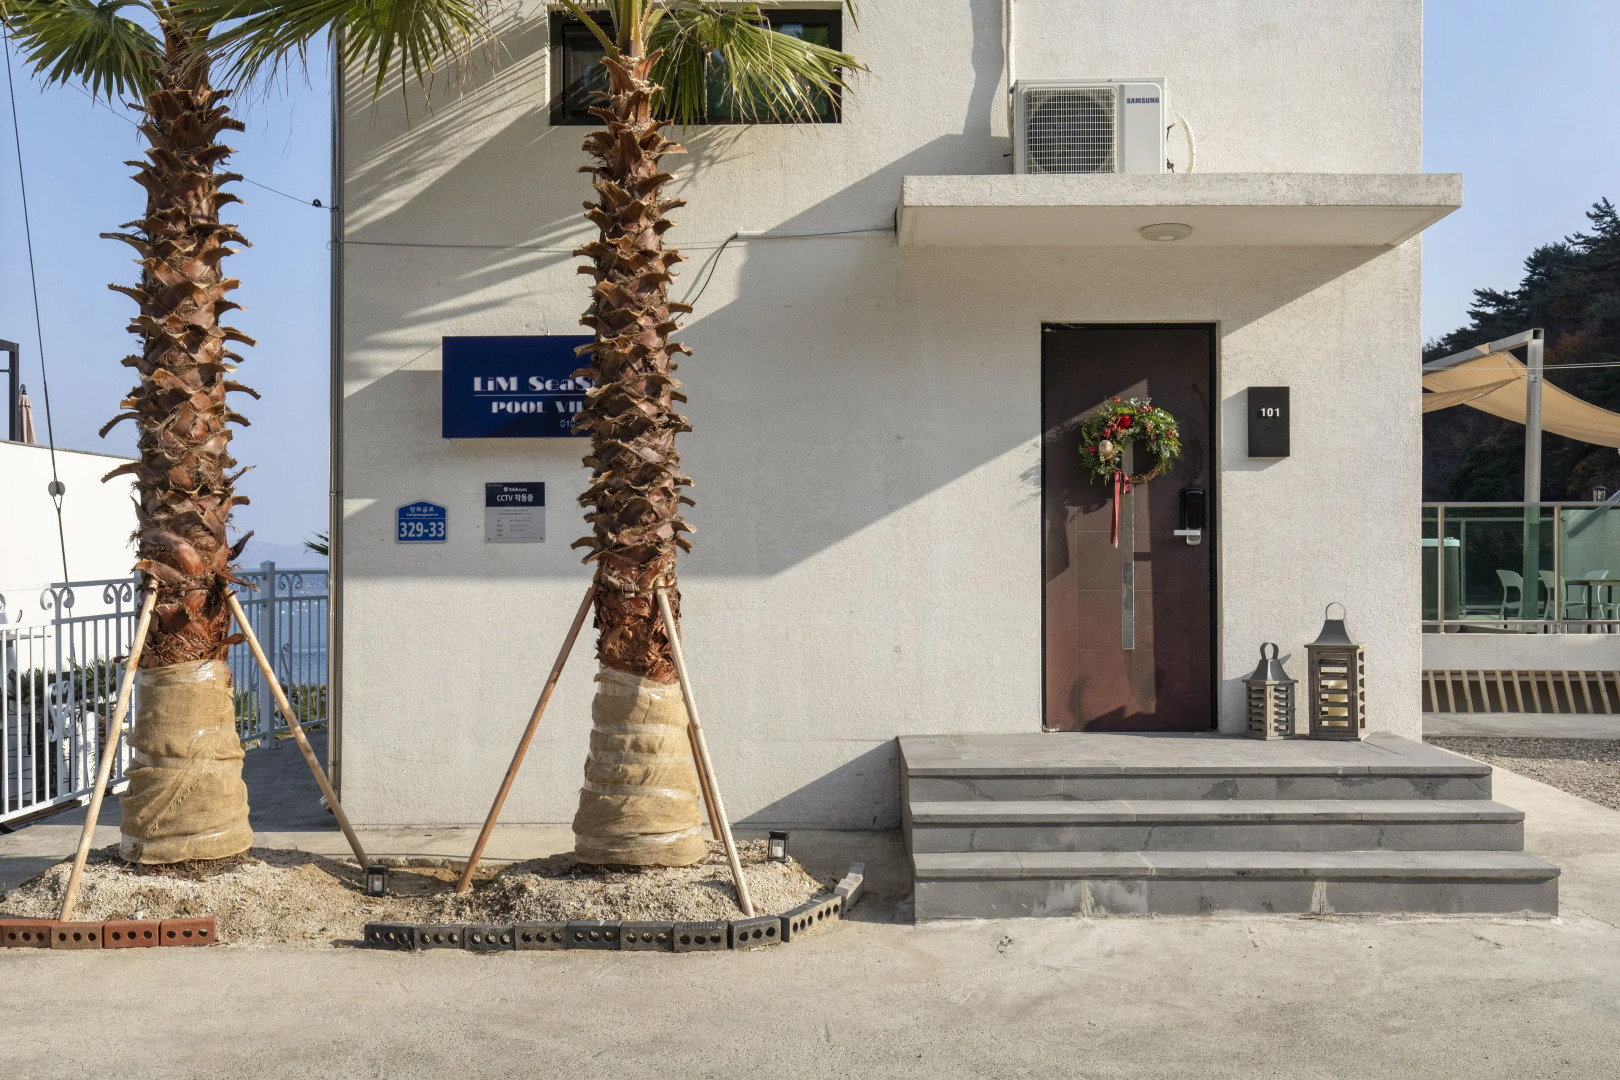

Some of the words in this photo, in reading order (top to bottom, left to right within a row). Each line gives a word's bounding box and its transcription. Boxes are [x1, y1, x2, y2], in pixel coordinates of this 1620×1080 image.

[473, 376, 518, 391] LiM
[528, 376, 594, 391] SeaS
[491, 401, 547, 414] POOL
[1260, 407, 1280, 417] 101
[496, 494, 513, 502] CCTV
[514, 493, 534, 503] 작동중
[399, 521, 445, 538] 329-33
